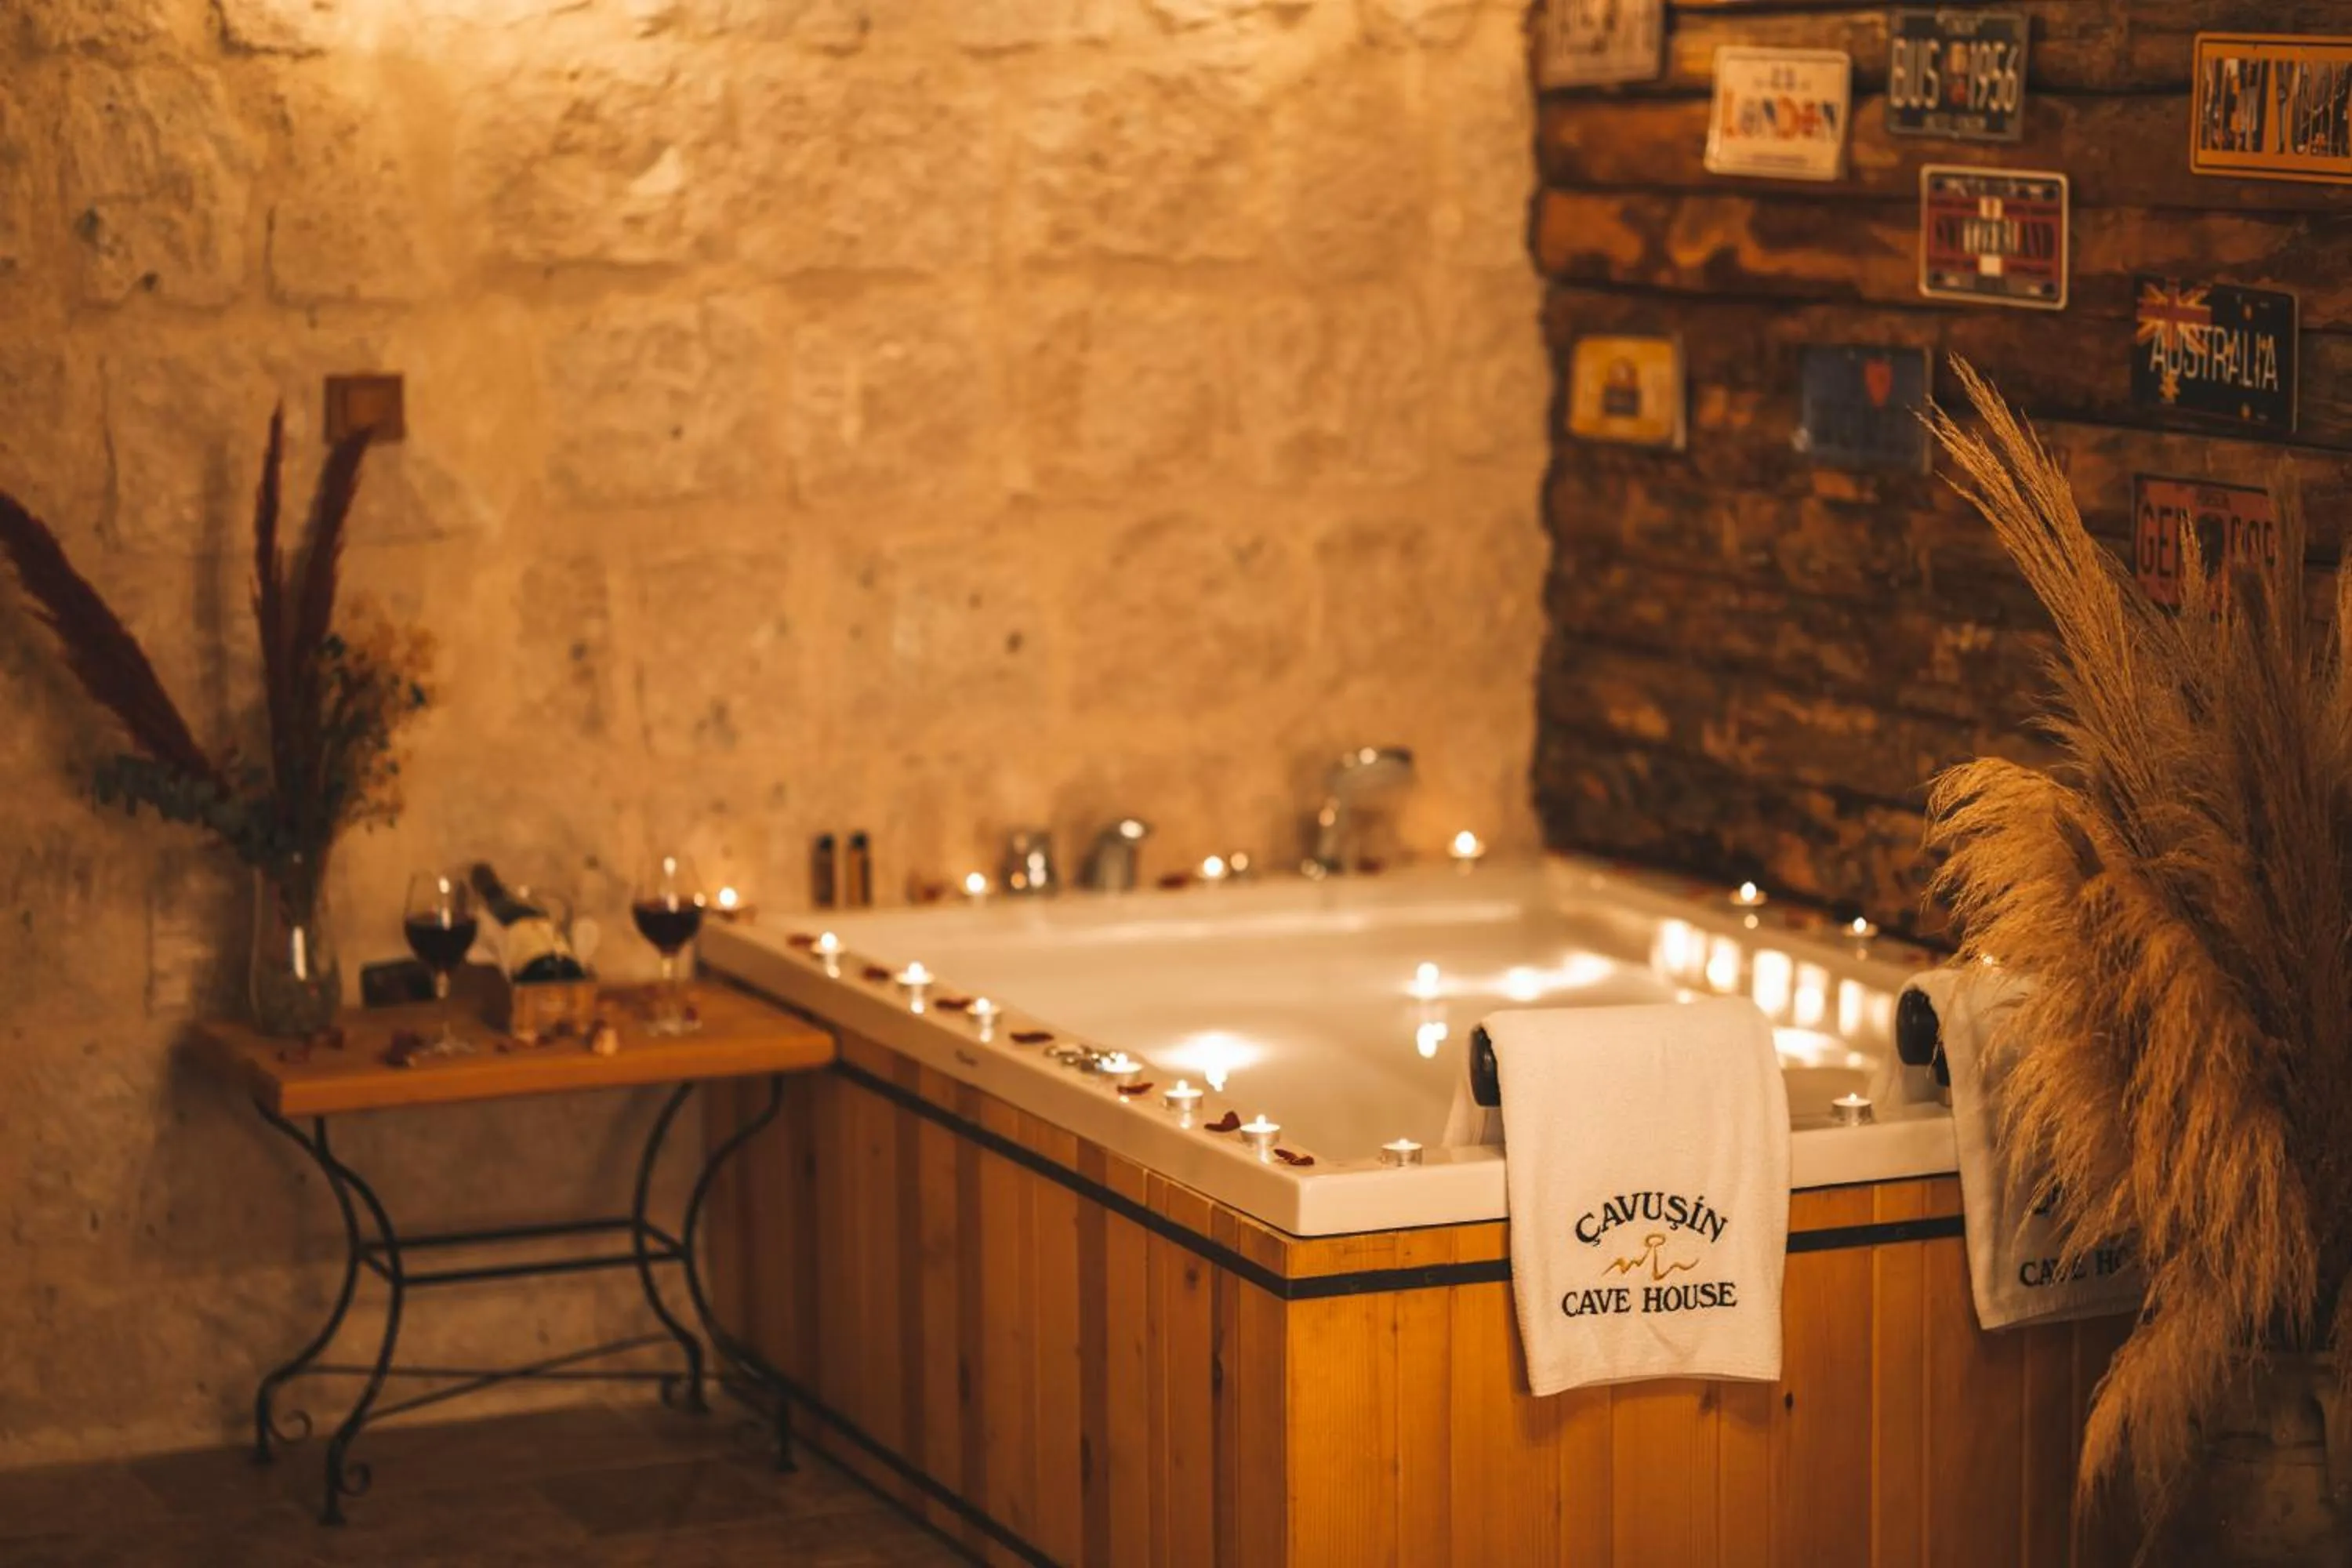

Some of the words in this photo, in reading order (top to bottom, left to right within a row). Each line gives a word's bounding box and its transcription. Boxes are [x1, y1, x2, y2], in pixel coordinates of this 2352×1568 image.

[1968, 42, 2020, 112] 1956
[2149, 325, 2279, 392] AUSTRALIA
[1575, 1192, 1728, 1247] ÇAVUŞİN
[1562, 1288, 1632, 1318] CAVE
[1642, 1282, 1737, 1313] HOUSE
